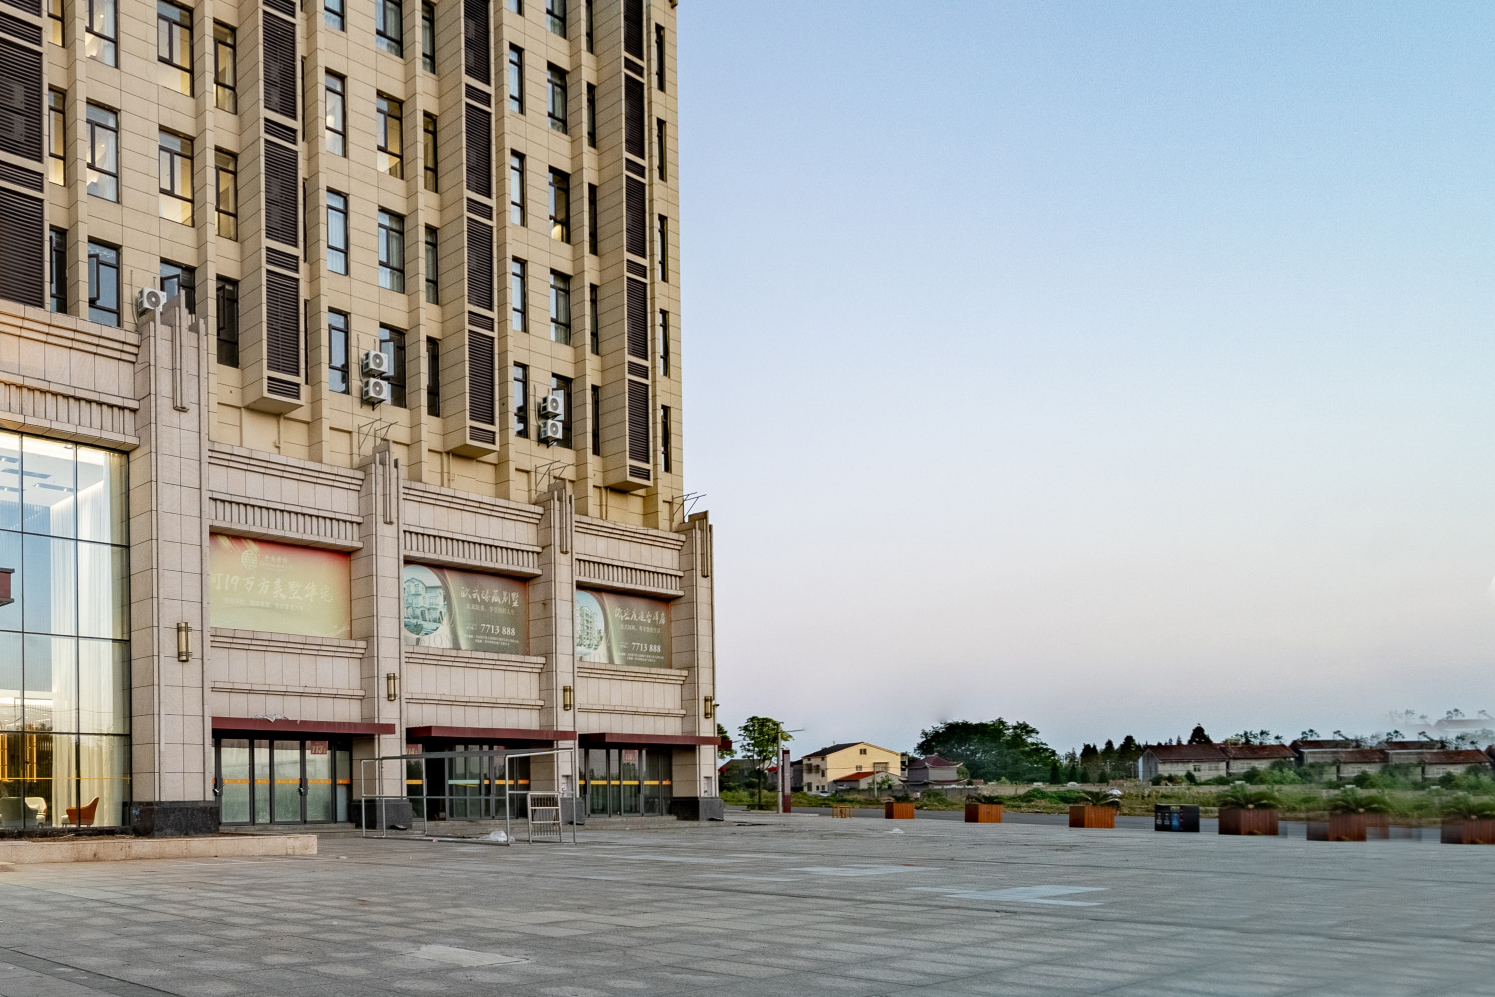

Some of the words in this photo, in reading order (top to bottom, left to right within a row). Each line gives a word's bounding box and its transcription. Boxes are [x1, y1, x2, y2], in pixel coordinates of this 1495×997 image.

[480, 623, 500, 635] 7713
[502, 626, 516, 636] 888
[631, 642, 647, 652] 7713
[649, 644, 661, 653] 888
